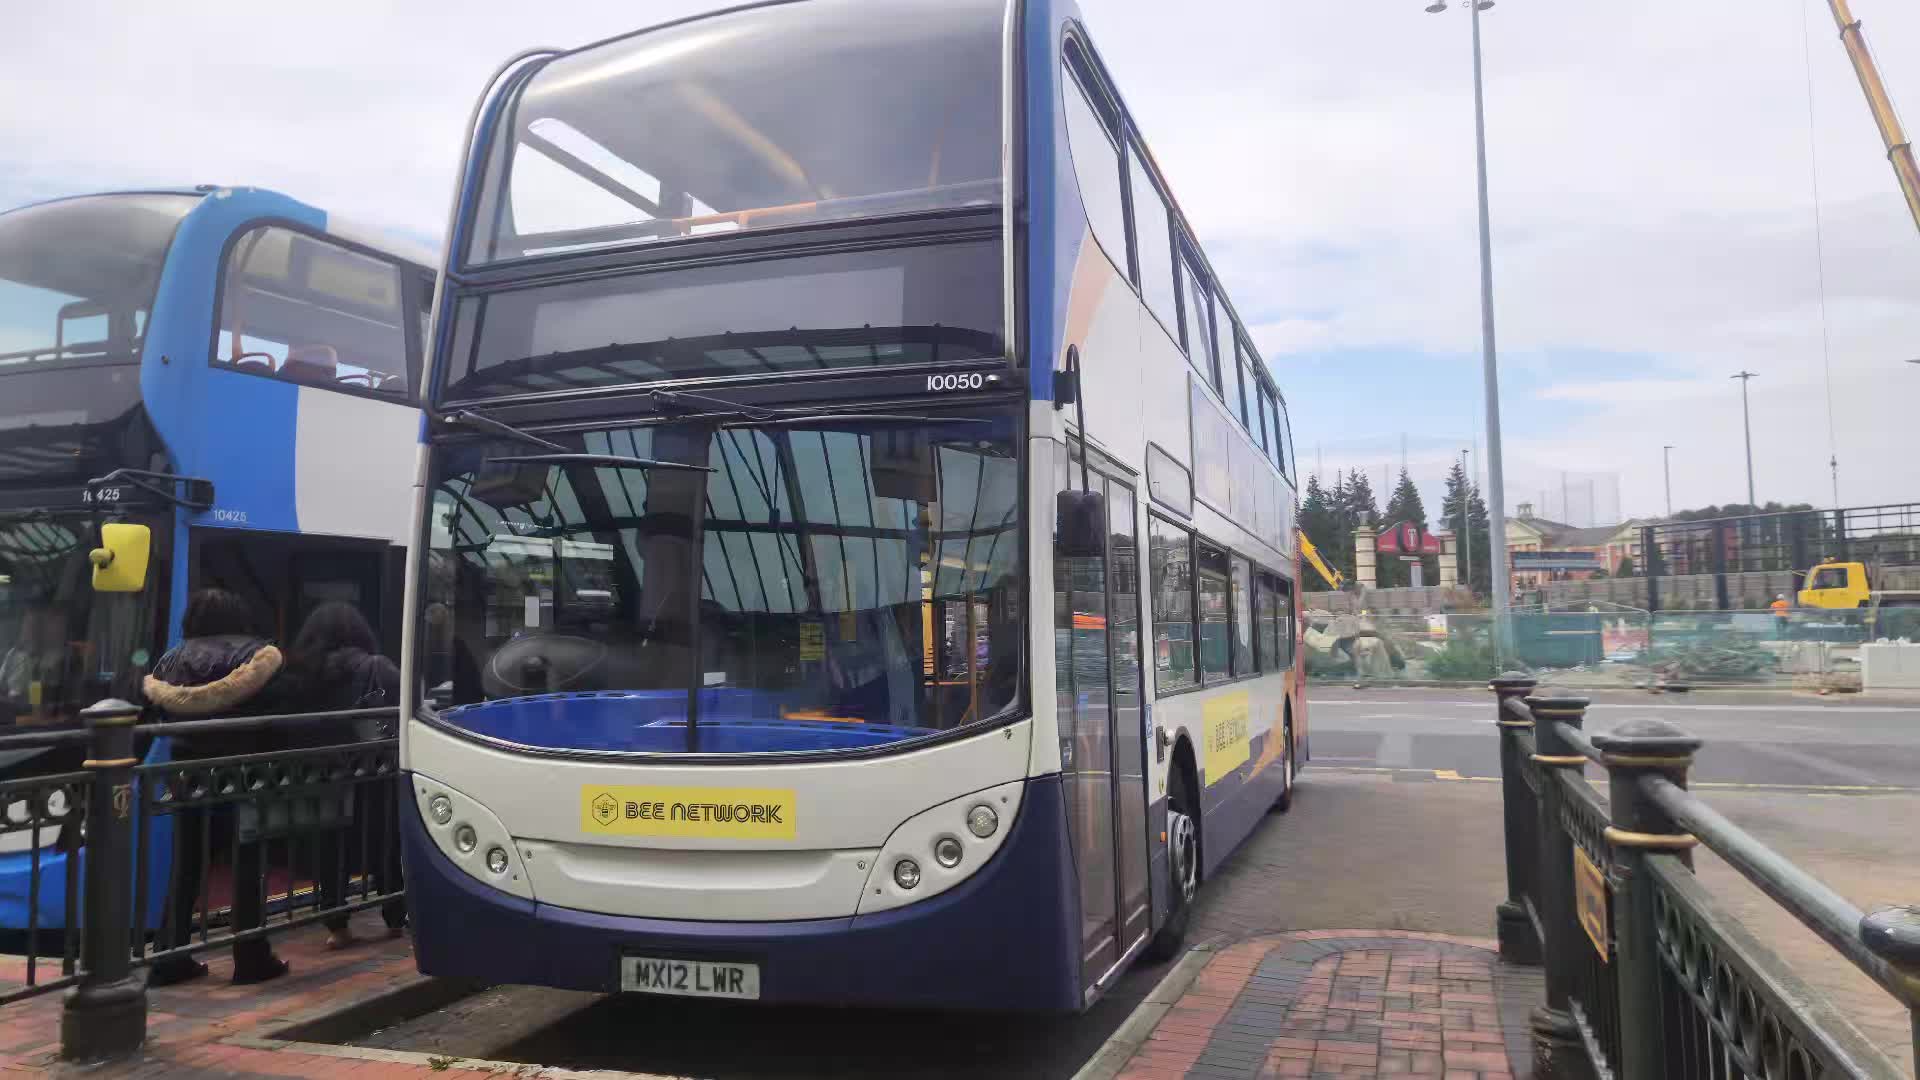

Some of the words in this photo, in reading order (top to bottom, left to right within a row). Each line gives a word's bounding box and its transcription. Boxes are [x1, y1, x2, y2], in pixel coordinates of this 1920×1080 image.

[927, 373, 983, 391] 10050
[213, 509, 247, 522] 10425
[625, 801, 665, 821] BEE
[670, 802, 783, 824] NETWORK
[635, 961, 689, 990] MX12
[695, 963, 745, 993] LWR
